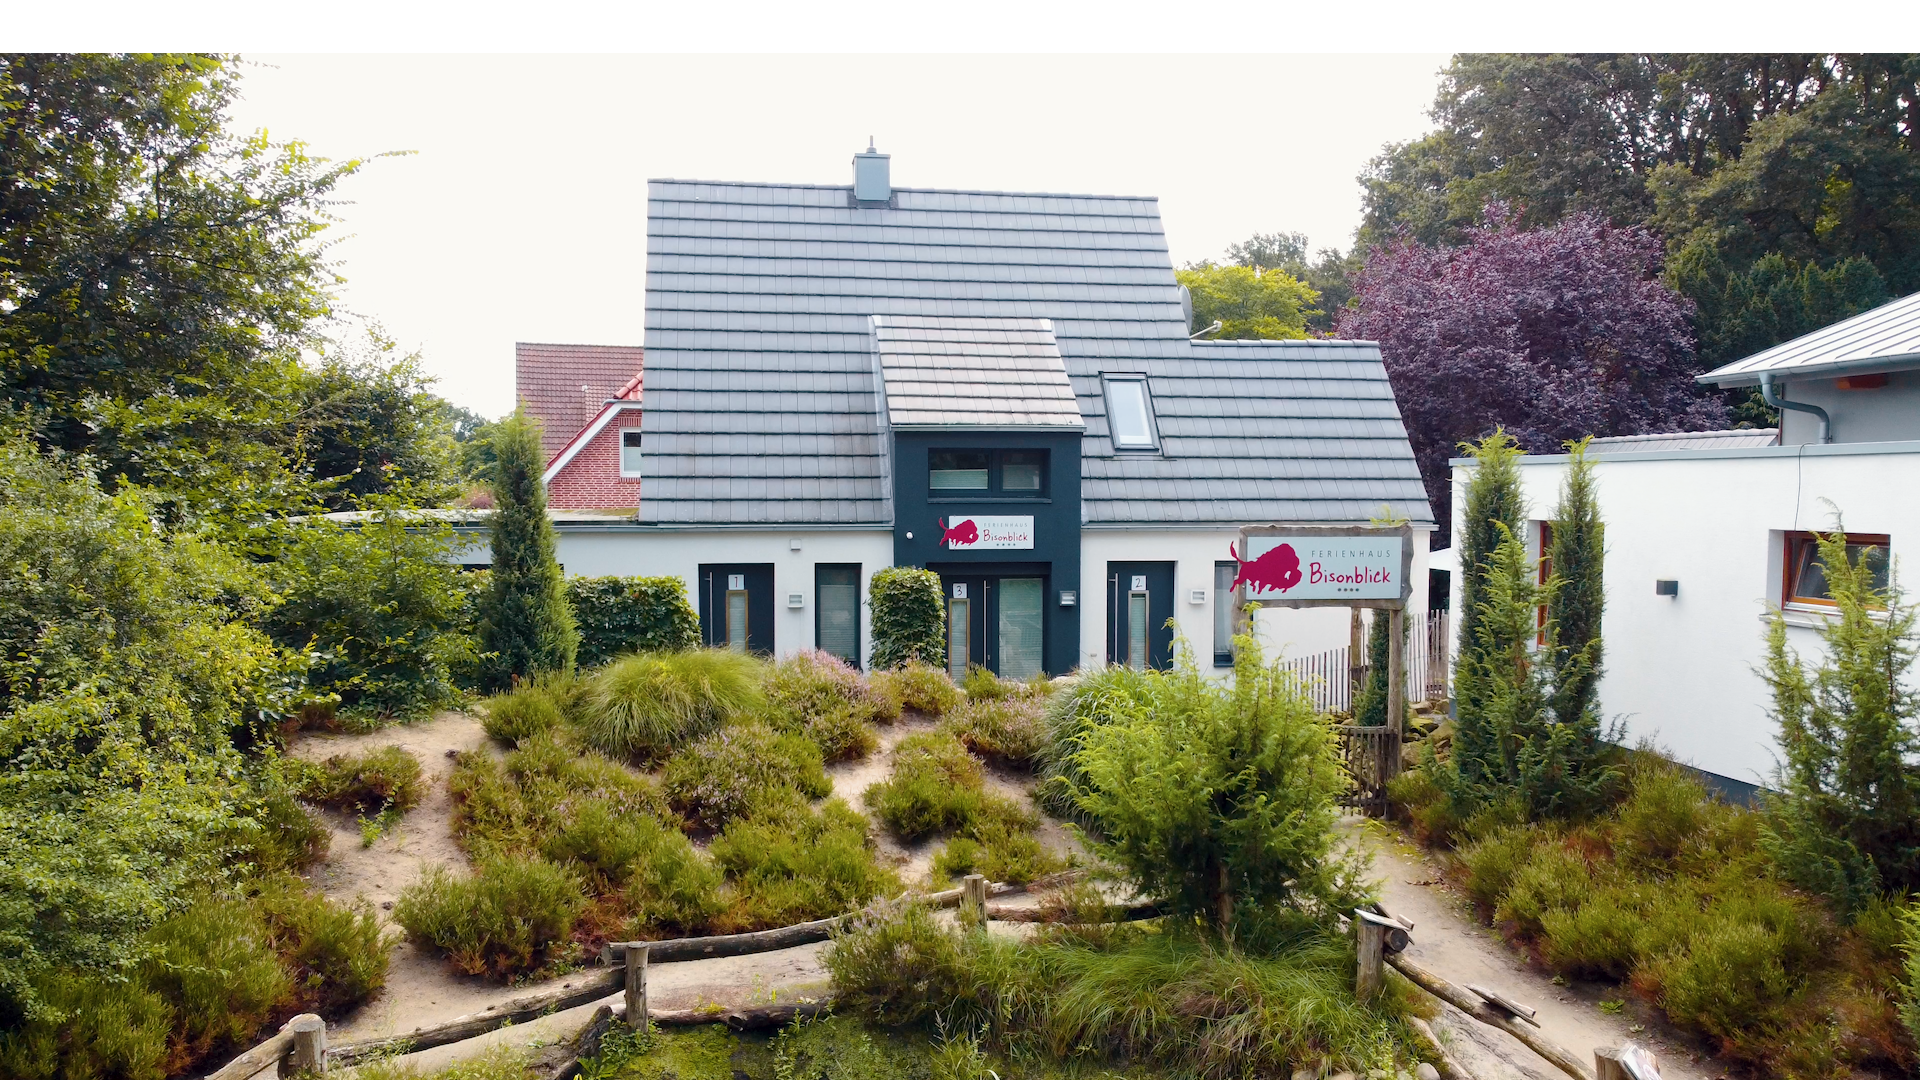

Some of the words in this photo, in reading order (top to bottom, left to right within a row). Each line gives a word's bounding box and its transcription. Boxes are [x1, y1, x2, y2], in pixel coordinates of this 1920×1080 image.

[983, 529, 1028, 541] Bisonblick
[1311, 550, 1391, 558] FERIENHAUS
[1309, 562, 1391, 584] Bisonblick
[734, 576, 738, 588] 1
[1135, 577, 1143, 588] 2
[956, 585, 963, 596] 3
